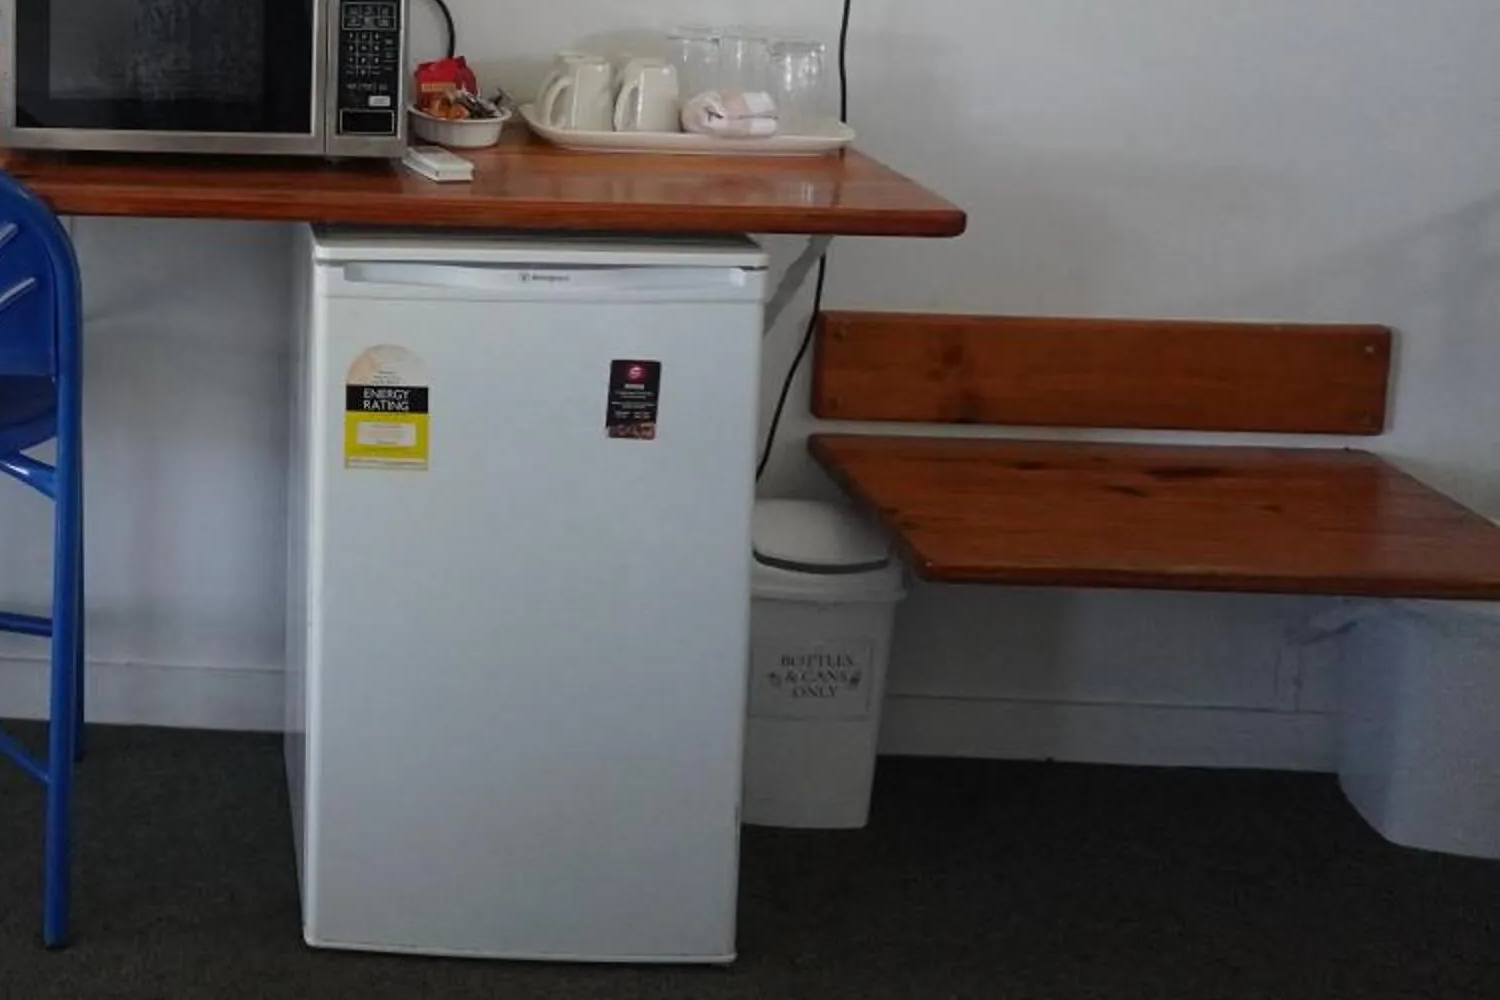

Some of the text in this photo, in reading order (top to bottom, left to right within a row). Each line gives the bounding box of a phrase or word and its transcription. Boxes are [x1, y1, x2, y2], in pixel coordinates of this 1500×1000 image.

[362, 388, 411, 399] ENERGY
[362, 400, 410, 411] RATING
[792, 686, 838, 697] ONLY
